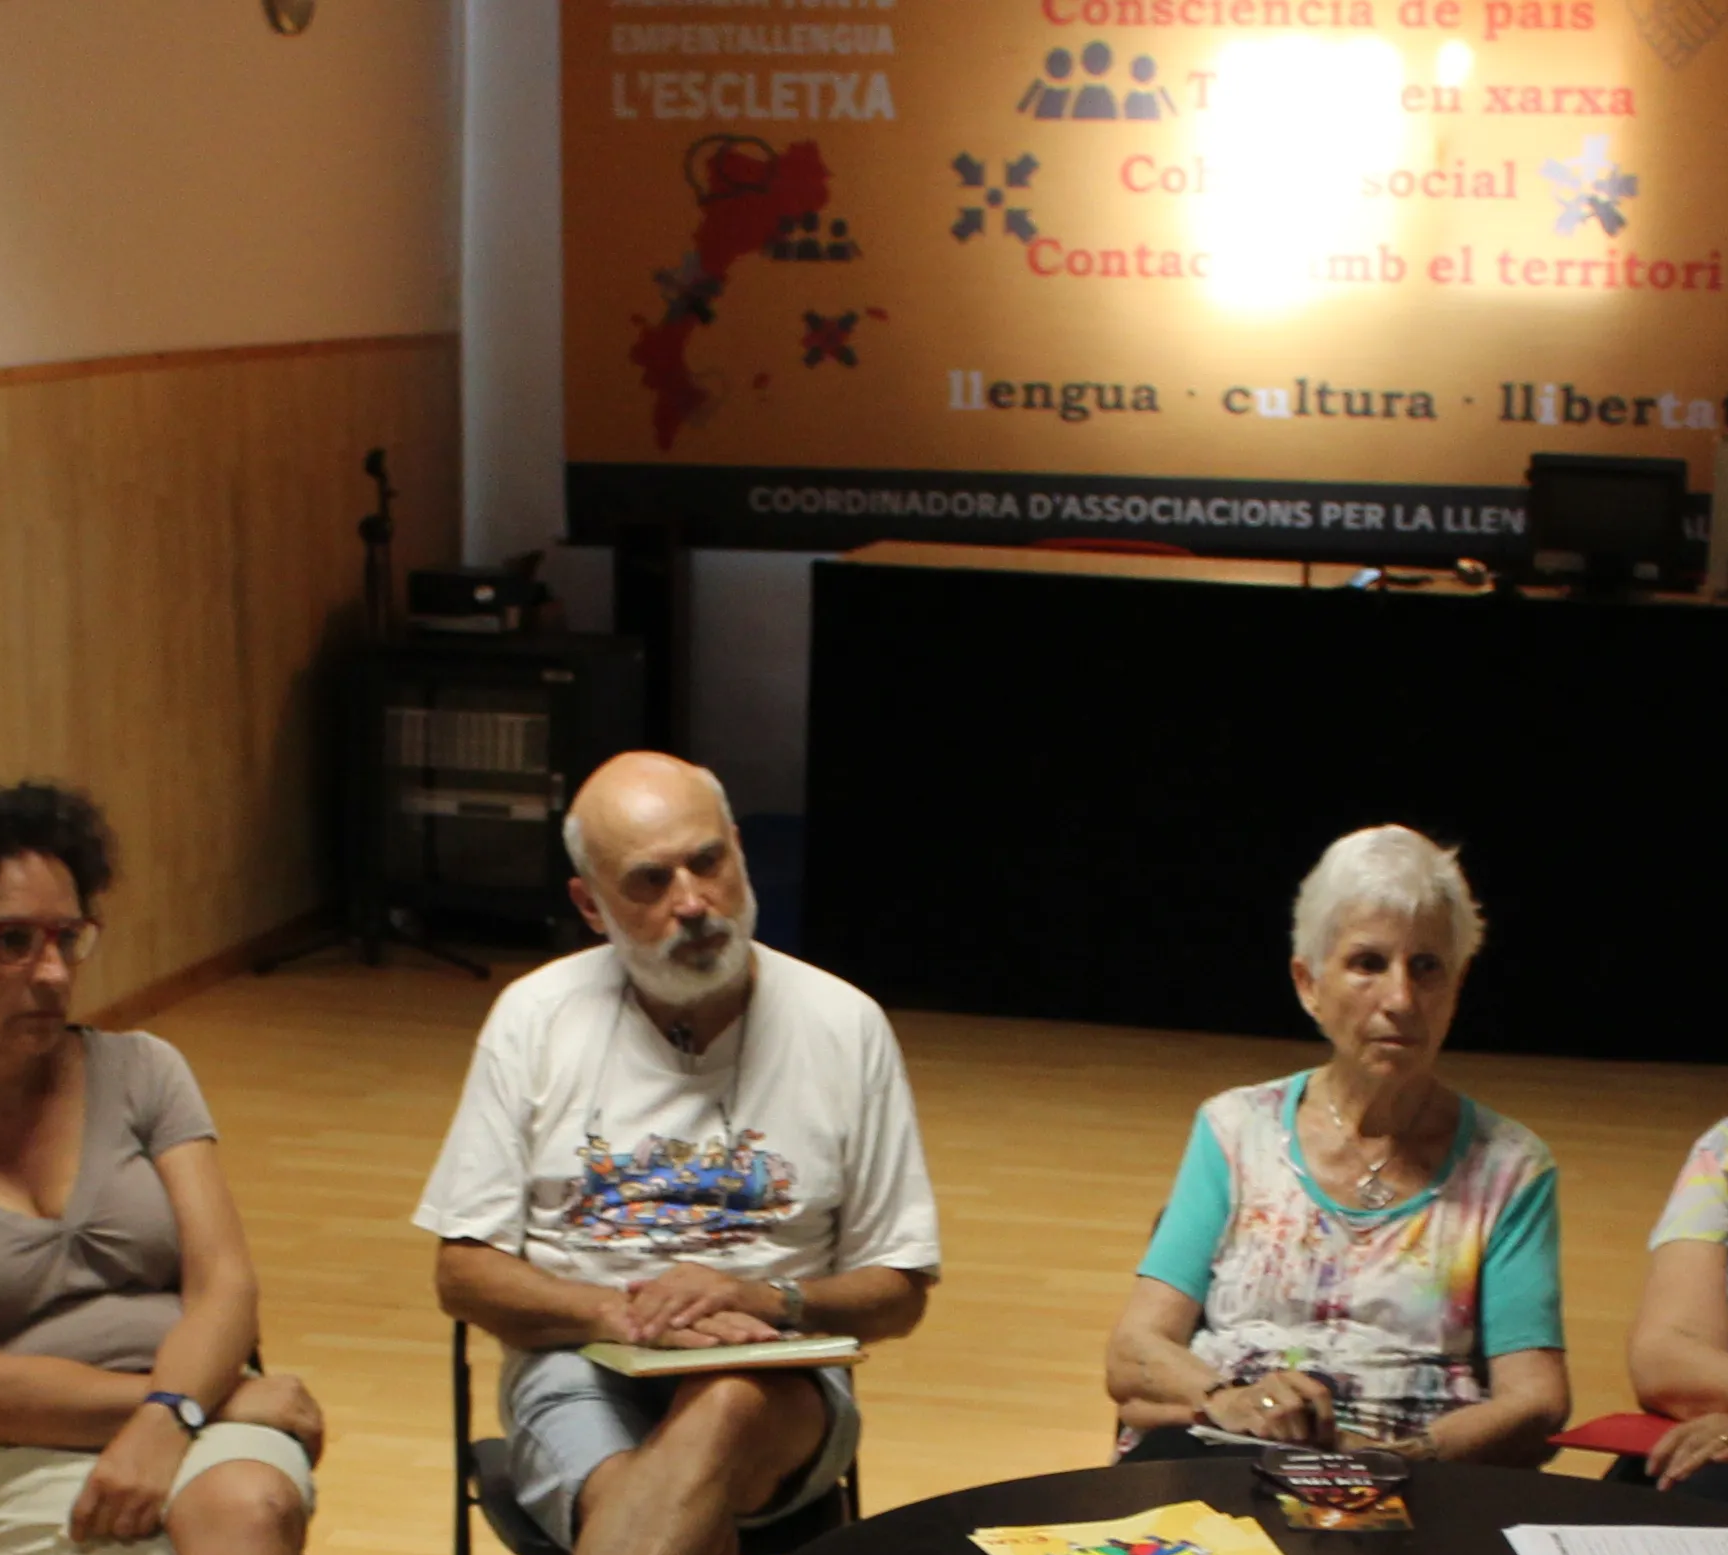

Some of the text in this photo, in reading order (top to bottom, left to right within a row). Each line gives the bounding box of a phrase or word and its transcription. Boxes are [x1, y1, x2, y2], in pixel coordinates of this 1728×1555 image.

[1413, 0, 1465, 30] de
[610, 71, 895, 121] L'ESCLETXA
[1401, 83, 1462, 116] en
[1484, 84, 1636, 118] xarxa
[1360, 159, 1519, 202] social
[1308, 243, 1406, 284] mb
[1426, 244, 1475, 285] el
[1499, 249, 1723, 294] territori
[948, 369, 1162, 424] llengua
[1222, 376, 1438, 420] cultura
[748, 486, 1527, 536] COORDINADORA D'ASSOCIACIONS PER LA LLEN
